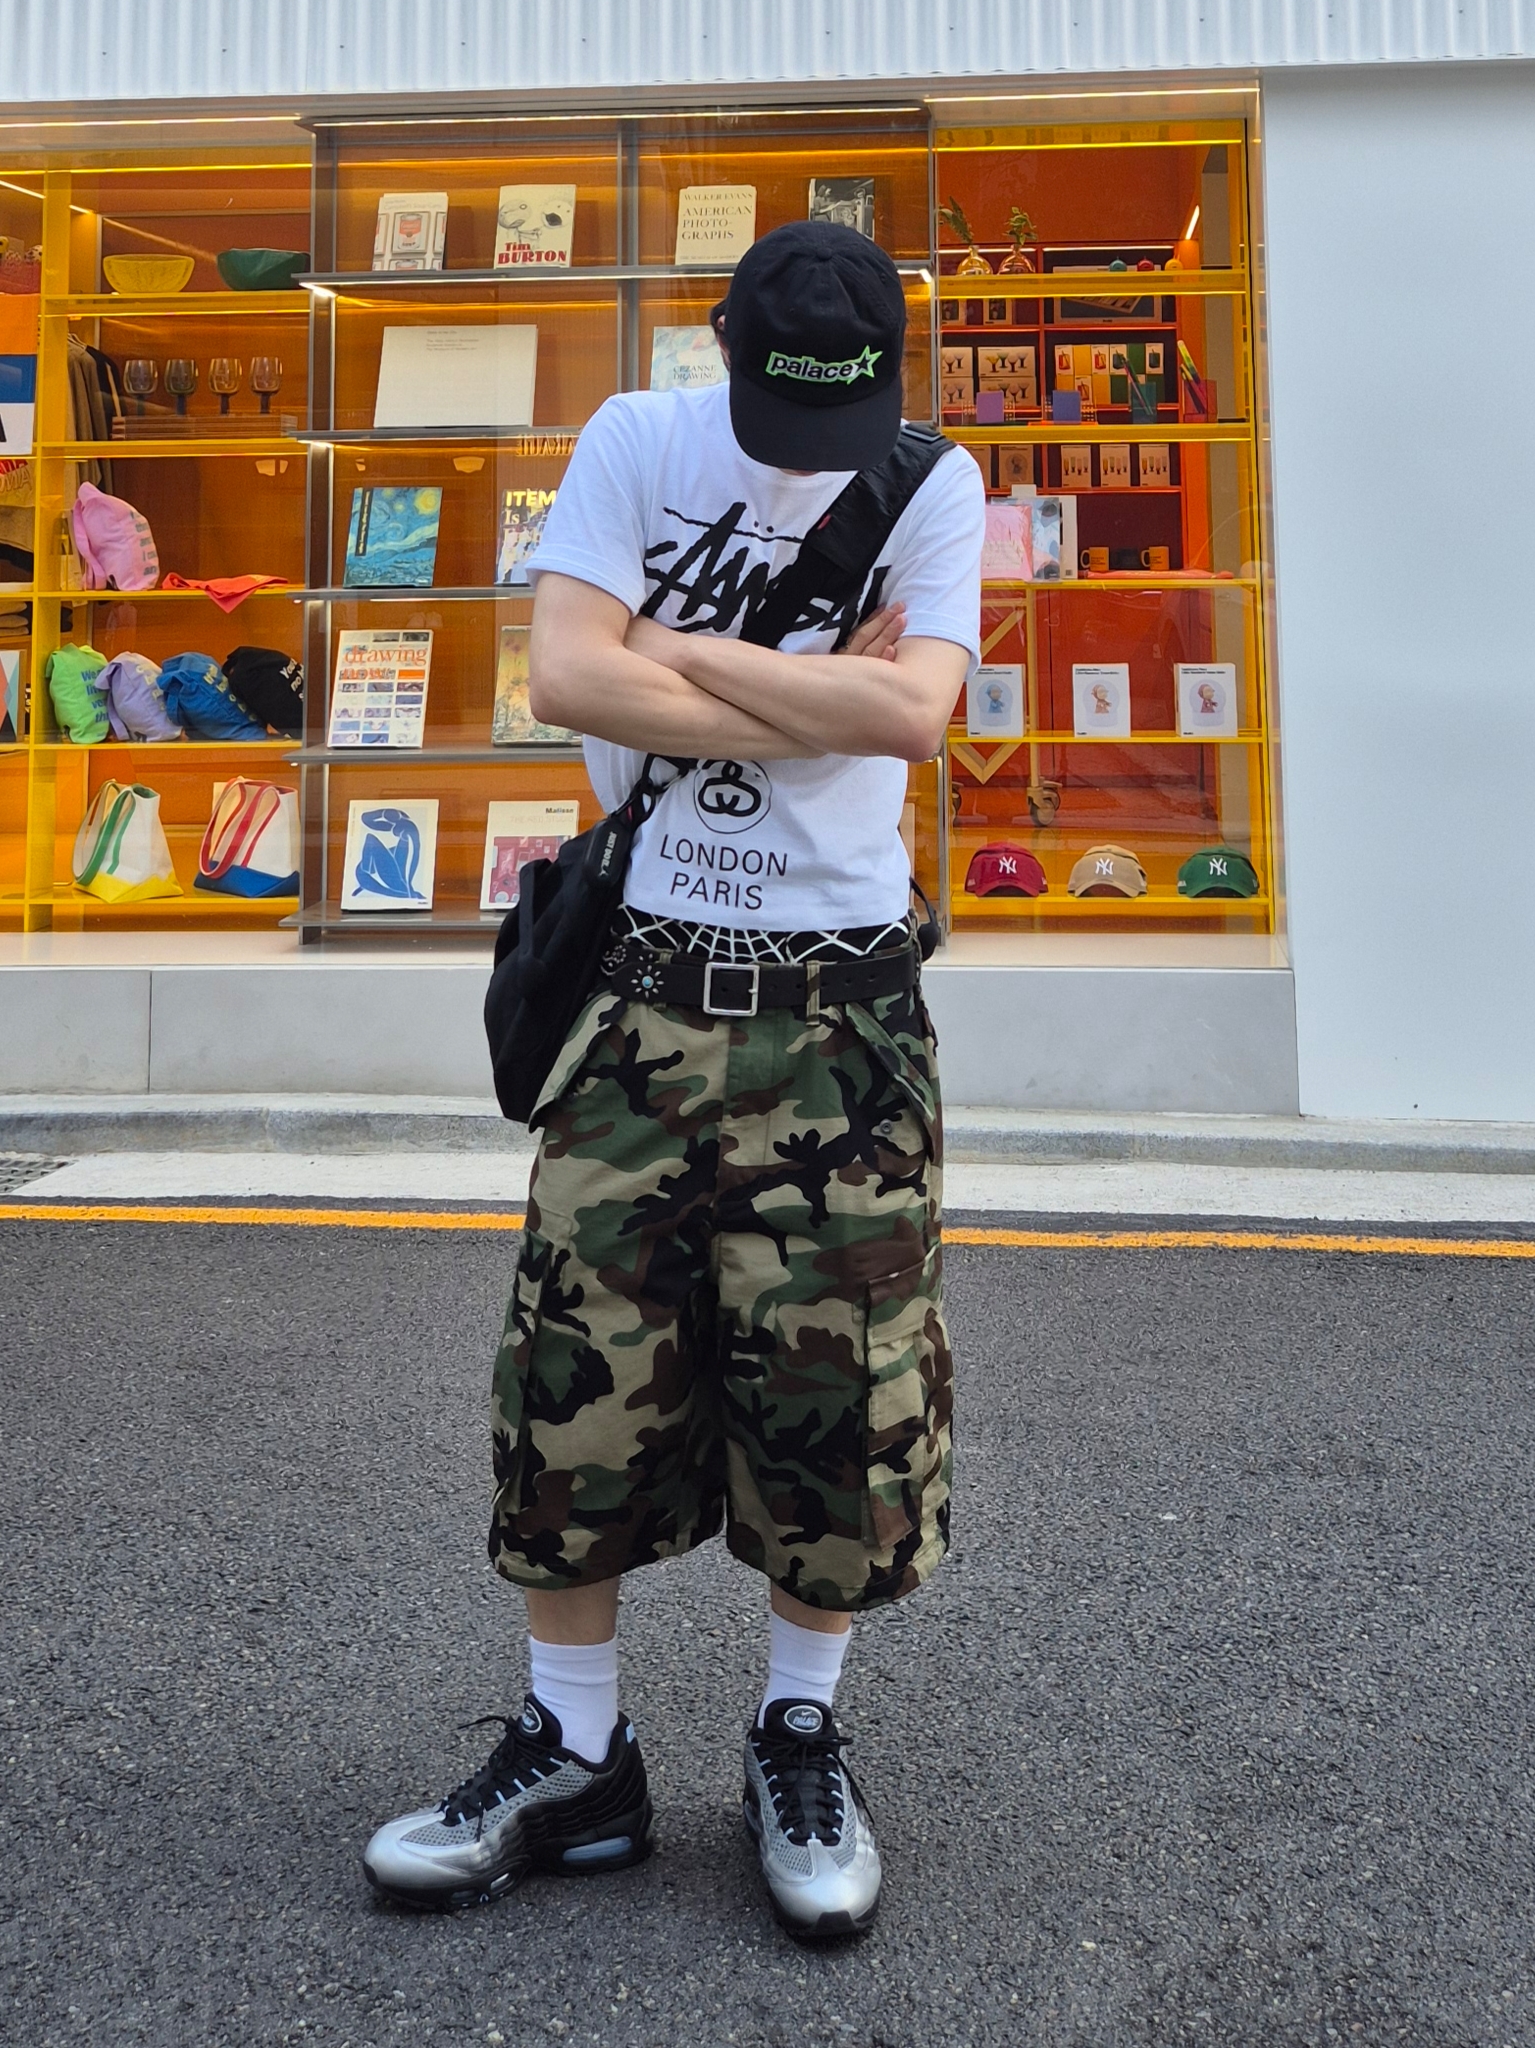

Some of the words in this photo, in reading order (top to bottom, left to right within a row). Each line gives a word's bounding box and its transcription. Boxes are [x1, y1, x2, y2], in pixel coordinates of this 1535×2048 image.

[684, 193, 722, 201] WALKER
[724, 191, 753, 200] EVANS
[683, 205, 753, 217] AMERICAN
[683, 219, 733, 229] PHOTO-
[681, 230, 734, 241] GRAPHS
[505, 242, 531, 252] Tim
[498, 250, 567, 265] BURTON
[771, 355, 853, 380] palace
[504, 509, 520, 525] Is
[344, 645, 427, 666] drawing
[660, 833, 788, 877] LONDON
[999, 856, 1017, 874] NY
[1095, 857, 1114, 875] NY
[1209, 857, 1228, 876] NY
[669, 871, 763, 911] PARIS
